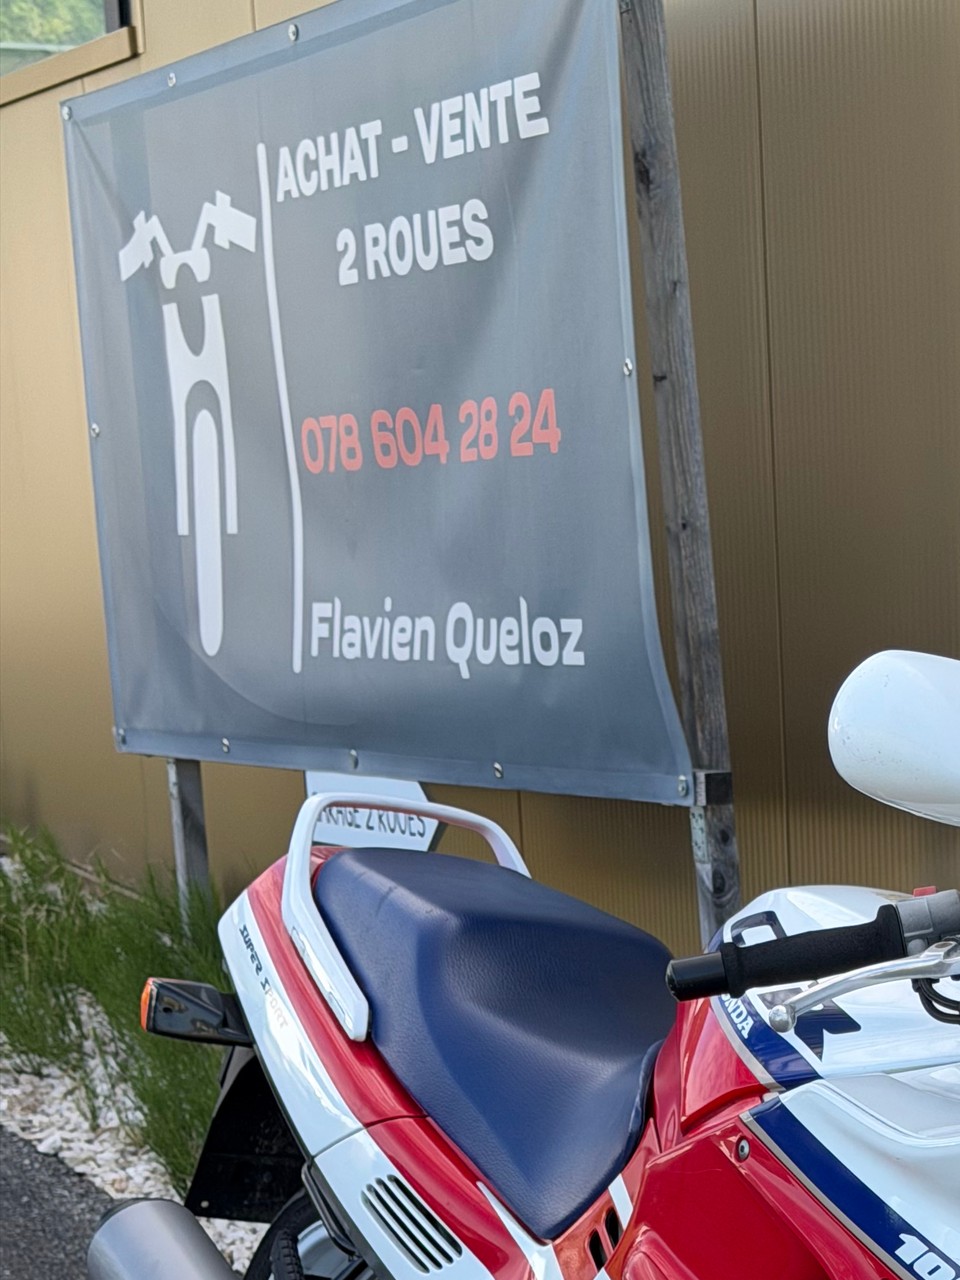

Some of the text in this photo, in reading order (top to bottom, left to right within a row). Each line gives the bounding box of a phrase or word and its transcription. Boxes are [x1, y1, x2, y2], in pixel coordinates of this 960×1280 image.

[276, 71, 550, 203] ACHAT - VENTE
[336, 198, 494, 286] 2 ROUES
[301, 387, 561, 474] 078 604 28 24
[310, 595, 585, 680] Flavien Queloz
[239, 924, 263, 977] SUPER
